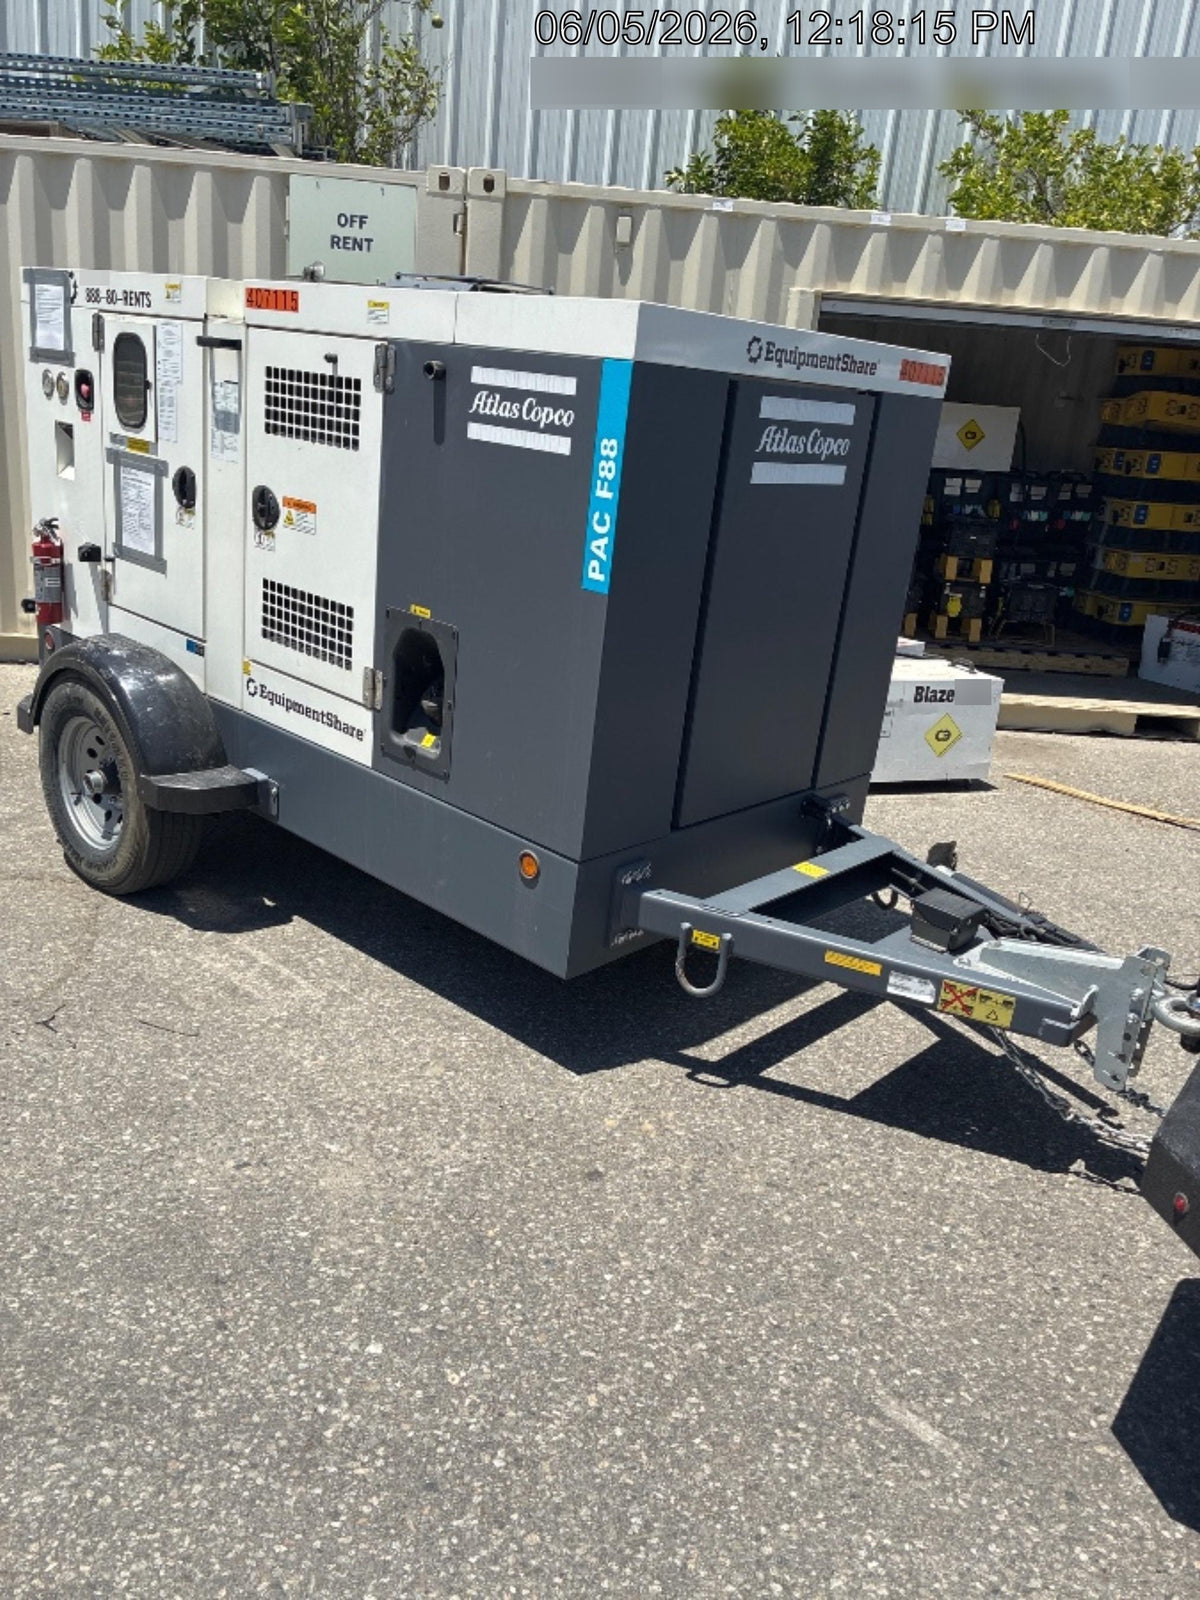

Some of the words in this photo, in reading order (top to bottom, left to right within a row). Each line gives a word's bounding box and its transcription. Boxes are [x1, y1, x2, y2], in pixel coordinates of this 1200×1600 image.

[337, 213, 368, 229] OFF
[331, 235, 374, 252] RENT
[246, 288, 299, 312] 407115
[764, 341, 878, 376] EquipmentShare
[469, 390, 520, 418] Atlas
[522, 397, 575, 428] Copco
[756, 425, 805, 453] Atlas
[806, 428, 850, 460] Copco
[595, 438, 618, 500] F88
[587, 510, 611, 582] PAC
[913, 685, 955, 703] Blaze
[259, 684, 364, 741] EquipmentShare
